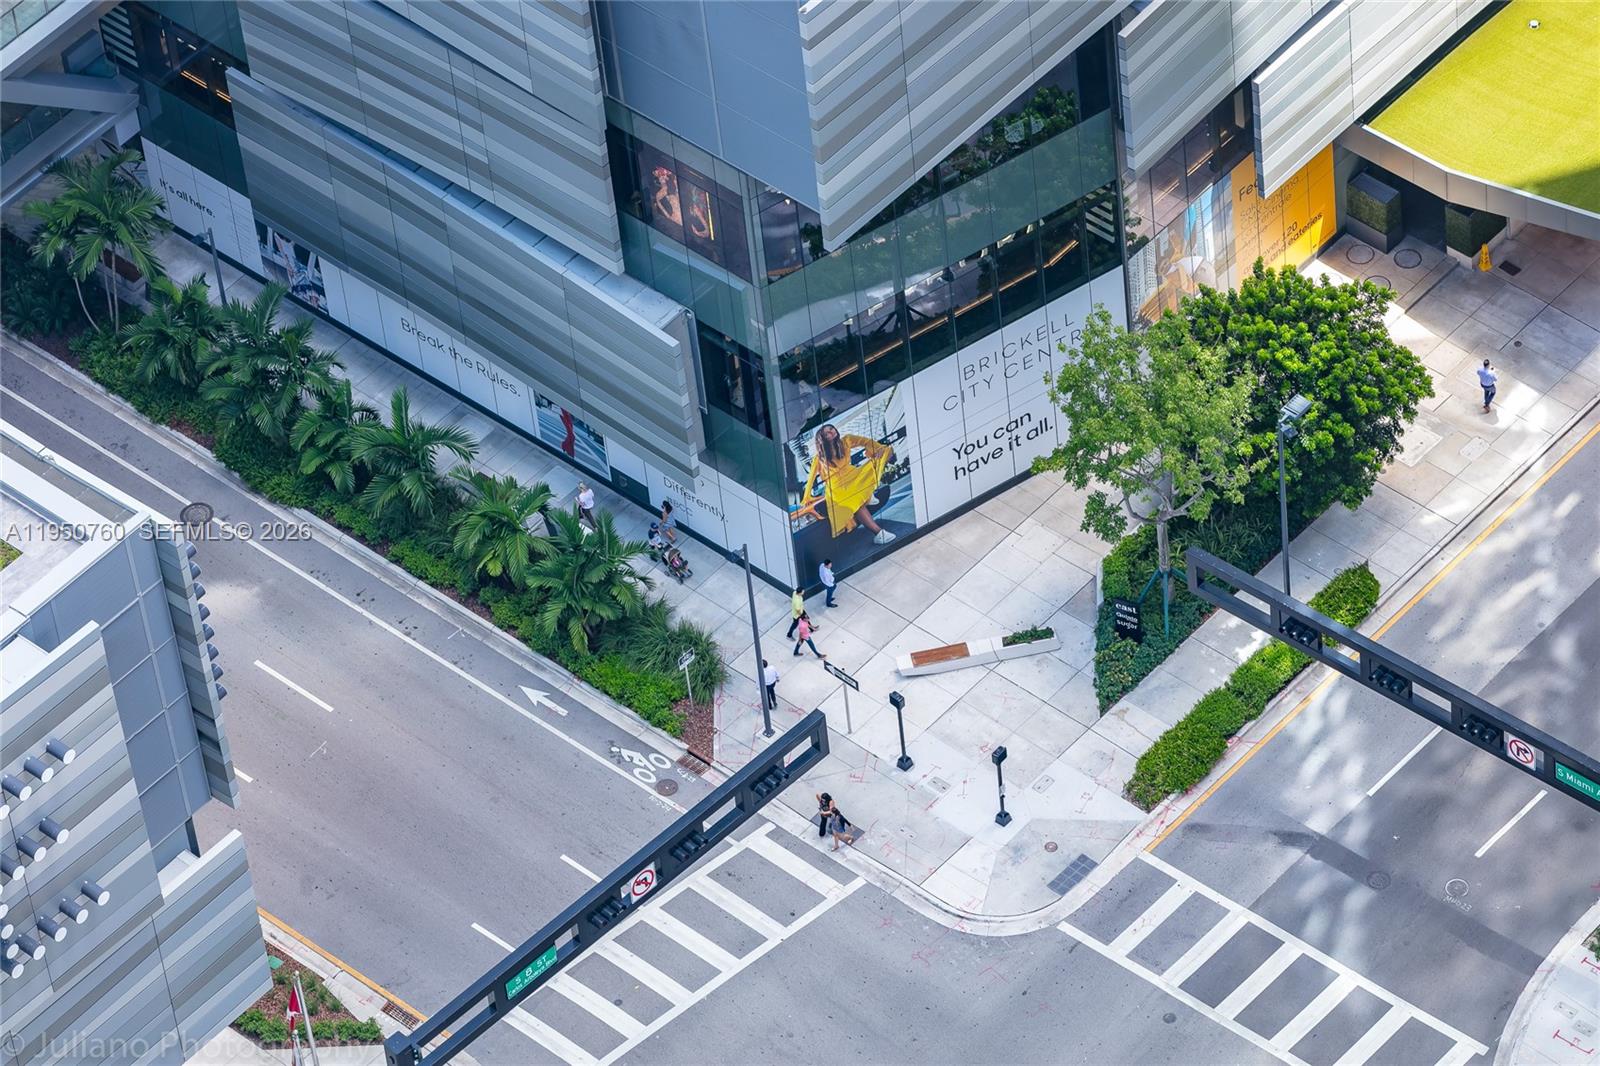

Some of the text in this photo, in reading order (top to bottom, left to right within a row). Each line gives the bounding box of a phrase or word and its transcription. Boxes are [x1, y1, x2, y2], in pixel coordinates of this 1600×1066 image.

[190, 196, 216, 218] here.
[1287, 211, 1323, 246] eateries
[400, 318, 521, 398] Break the Rules.
[943, 329, 1081, 411] CITY CENTR
[963, 313, 1074, 381] BRICKELL
[952, 412, 1032, 461] You can
[954, 417, 1054, 480] have it all.
[663, 476, 729, 523] Differently.
[1557, 767, 1564, 777] S
[1566, 772, 1594, 793] Miami
[525, 966, 533, 977] 8
[536, 954, 547, 968] ST
